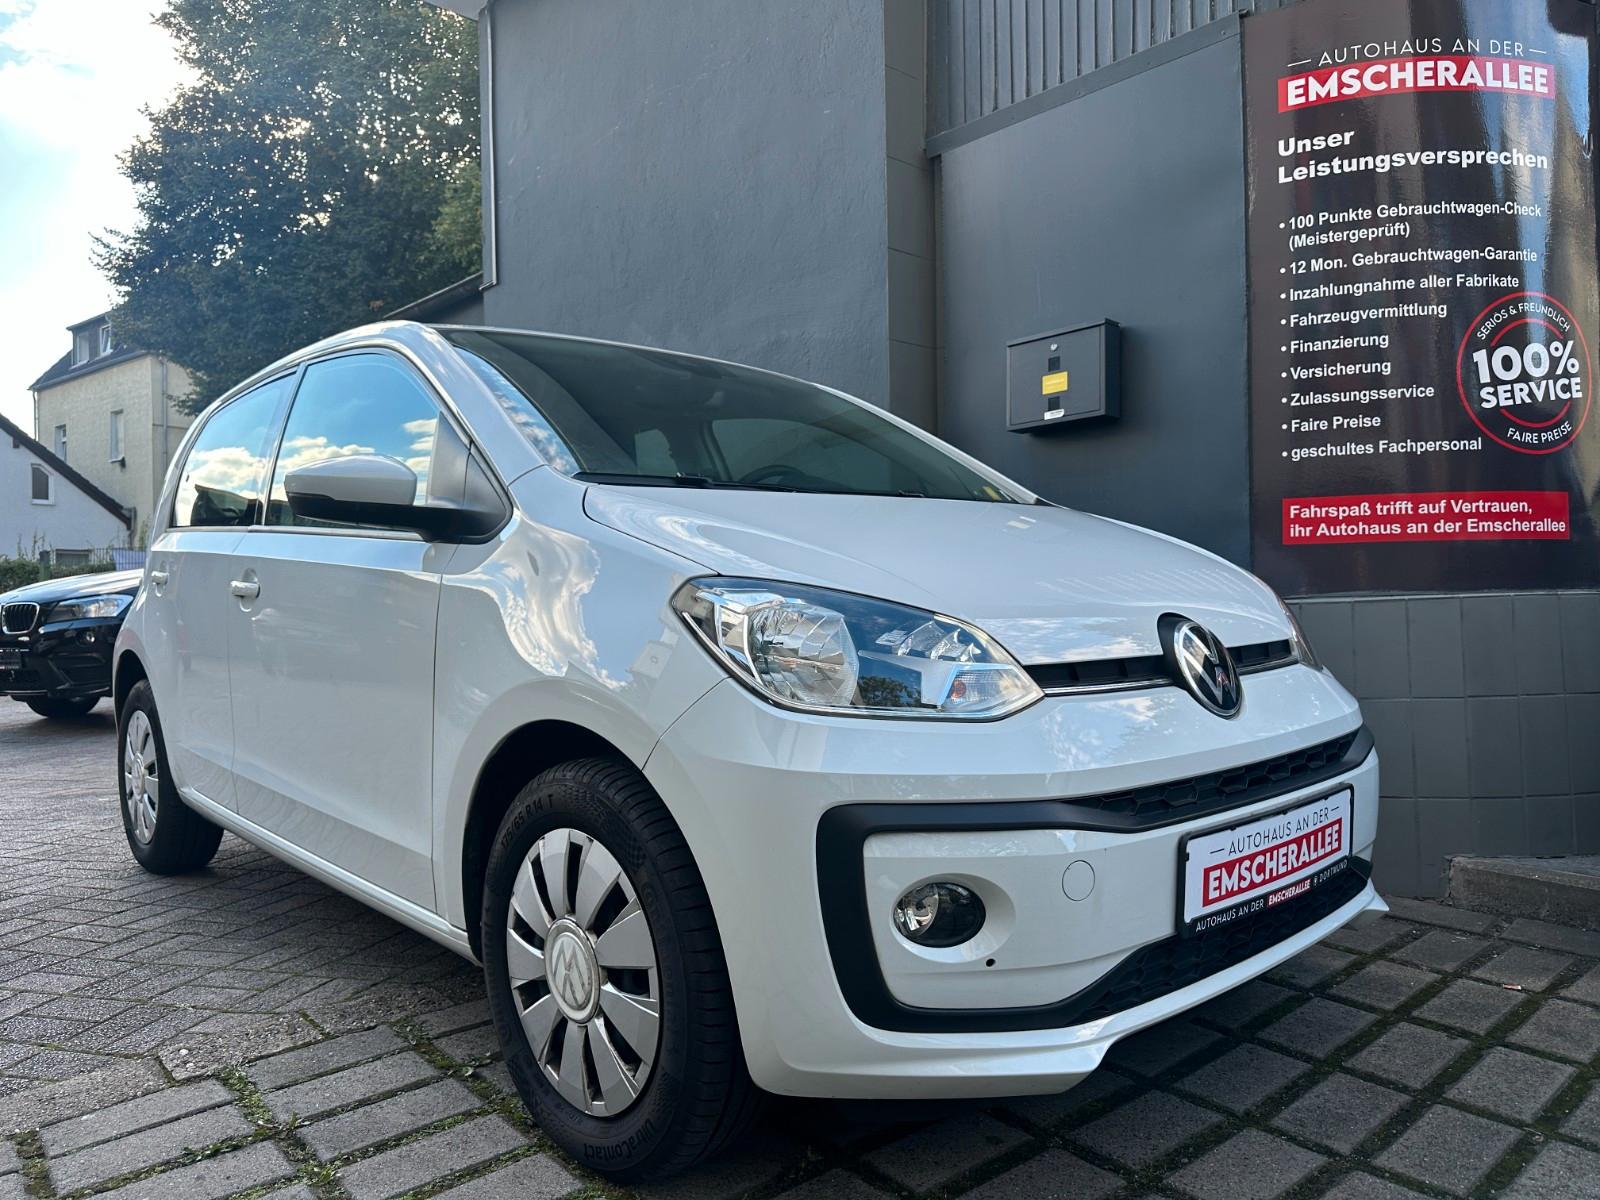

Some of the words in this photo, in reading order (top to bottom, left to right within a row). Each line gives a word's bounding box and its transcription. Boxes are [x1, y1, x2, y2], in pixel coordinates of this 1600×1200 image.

[1318, 38, 1442, 67] AUTOHAUS
[1452, 38, 1480, 53] AN
[1489, 40, 1524, 57] DER
[1287, 60, 1549, 107] EMSCHERALLEE
[1278, 128, 1355, 157] Unser
[1278, 148, 1548, 184] Leistungsversprechen
[1288, 215, 1314, 231] 100
[1318, 207, 1372, 227] Punkte
[1376, 201, 1542, 219] Gebrauchtwagen-Check
[1288, 221, 1410, 251] (Meistergeprüft)
[1289, 260, 1307, 275] 12
[1310, 256, 1348, 273] Mon.
[1352, 246, 1537, 268] Gebrauchtwagen-Garantie
[1289, 277, 1416, 301] Inzahlungnahme
[1419, 275, 1452, 289] aller
[1456, 274, 1520, 289] Fabrikate
[1290, 303, 1448, 328] Fahrzeugvermittlung
[1476, 308, 1509, 341] SERIÖS
[1509, 305, 1517, 316] &
[1518, 302, 1571, 333] FREUNDLICH
[1290, 334, 1389, 354] Finanzierung
[1290, 360, 1392, 381] Versicherung
[1472, 340, 1580, 384] 100%
[1290, 385, 1435, 407] Zulassungsservice
[1479, 377, 1583, 409] SERVICE
[1291, 417, 1329, 433] Faire
[1332, 414, 1381, 430] Preise
[1507, 427, 1539, 444] FAIRE
[1541, 420, 1573, 443] PREISE
[1291, 442, 1374, 462] geschultes
[1378, 437, 1483, 457] Fachpersonal
[1290, 502, 1372, 520] Fahrspaß
[1375, 500, 1413, 516] trifft
[1418, 500, 1446, 515] auf
[1450, 499, 1533, 516] Vertrauen,
[1290, 522, 1315, 538] ihr
[1316, 520, 1402, 537] Autohaus
[1406, 522, 1428, 534] an
[1433, 519, 1461, 533] der
[1467, 518, 1566, 534] Emscherallee
[1228, 823, 1292, 857] AUTOHAUS
[1295, 817, 1309, 833] AN
[1312, 807, 1329, 826] DER
[1208, 824, 1340, 901] EMSCHERALLEE
[1195, 910, 1237, 934] AUTOHAUS
[1238, 905, 1250, 917] AN
[1250, 898, 1265, 912] DER
[1268, 879, 1311, 906] EMSCHERALLEE
